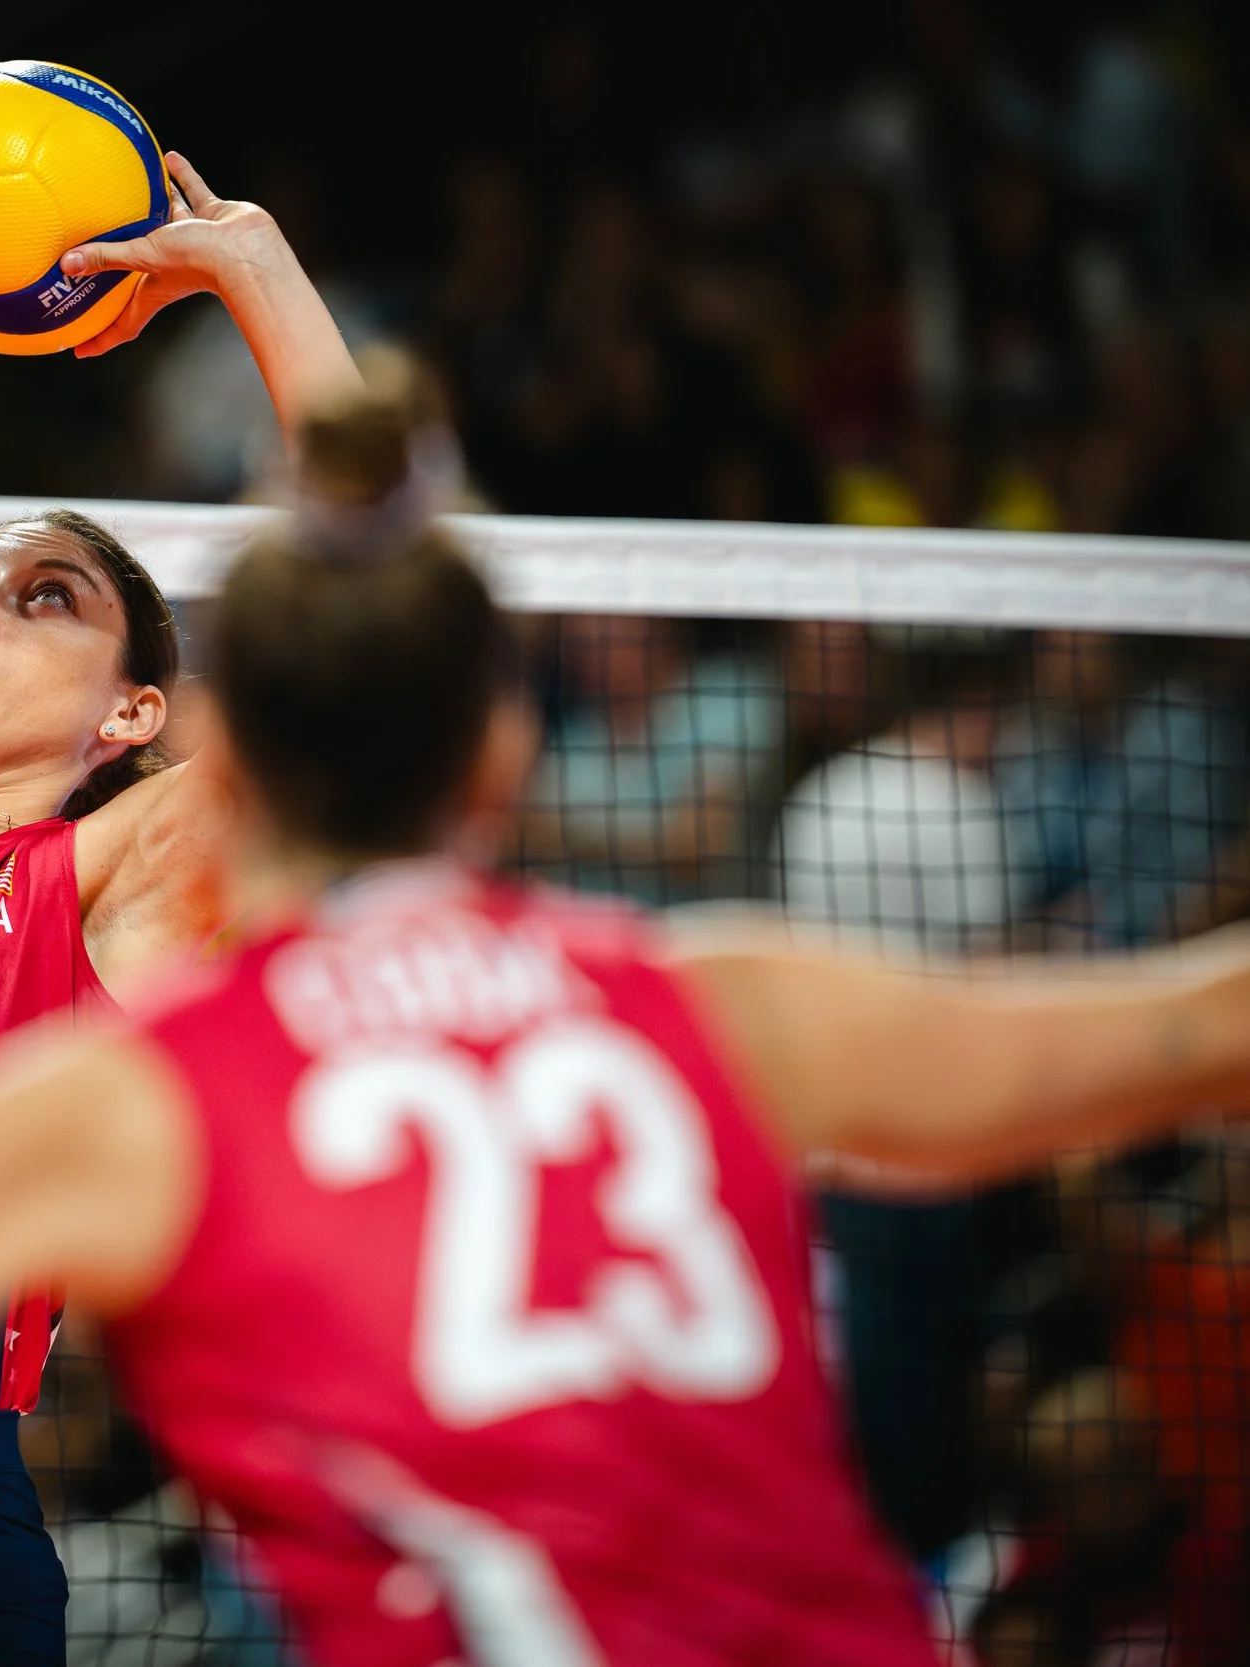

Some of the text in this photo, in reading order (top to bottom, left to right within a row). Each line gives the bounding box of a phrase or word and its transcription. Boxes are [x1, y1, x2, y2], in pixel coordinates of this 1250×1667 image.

[38, 273, 83, 308] FIV
[54, 282, 96, 317] APPROVED
[296, 1021, 774, 1424] 23
